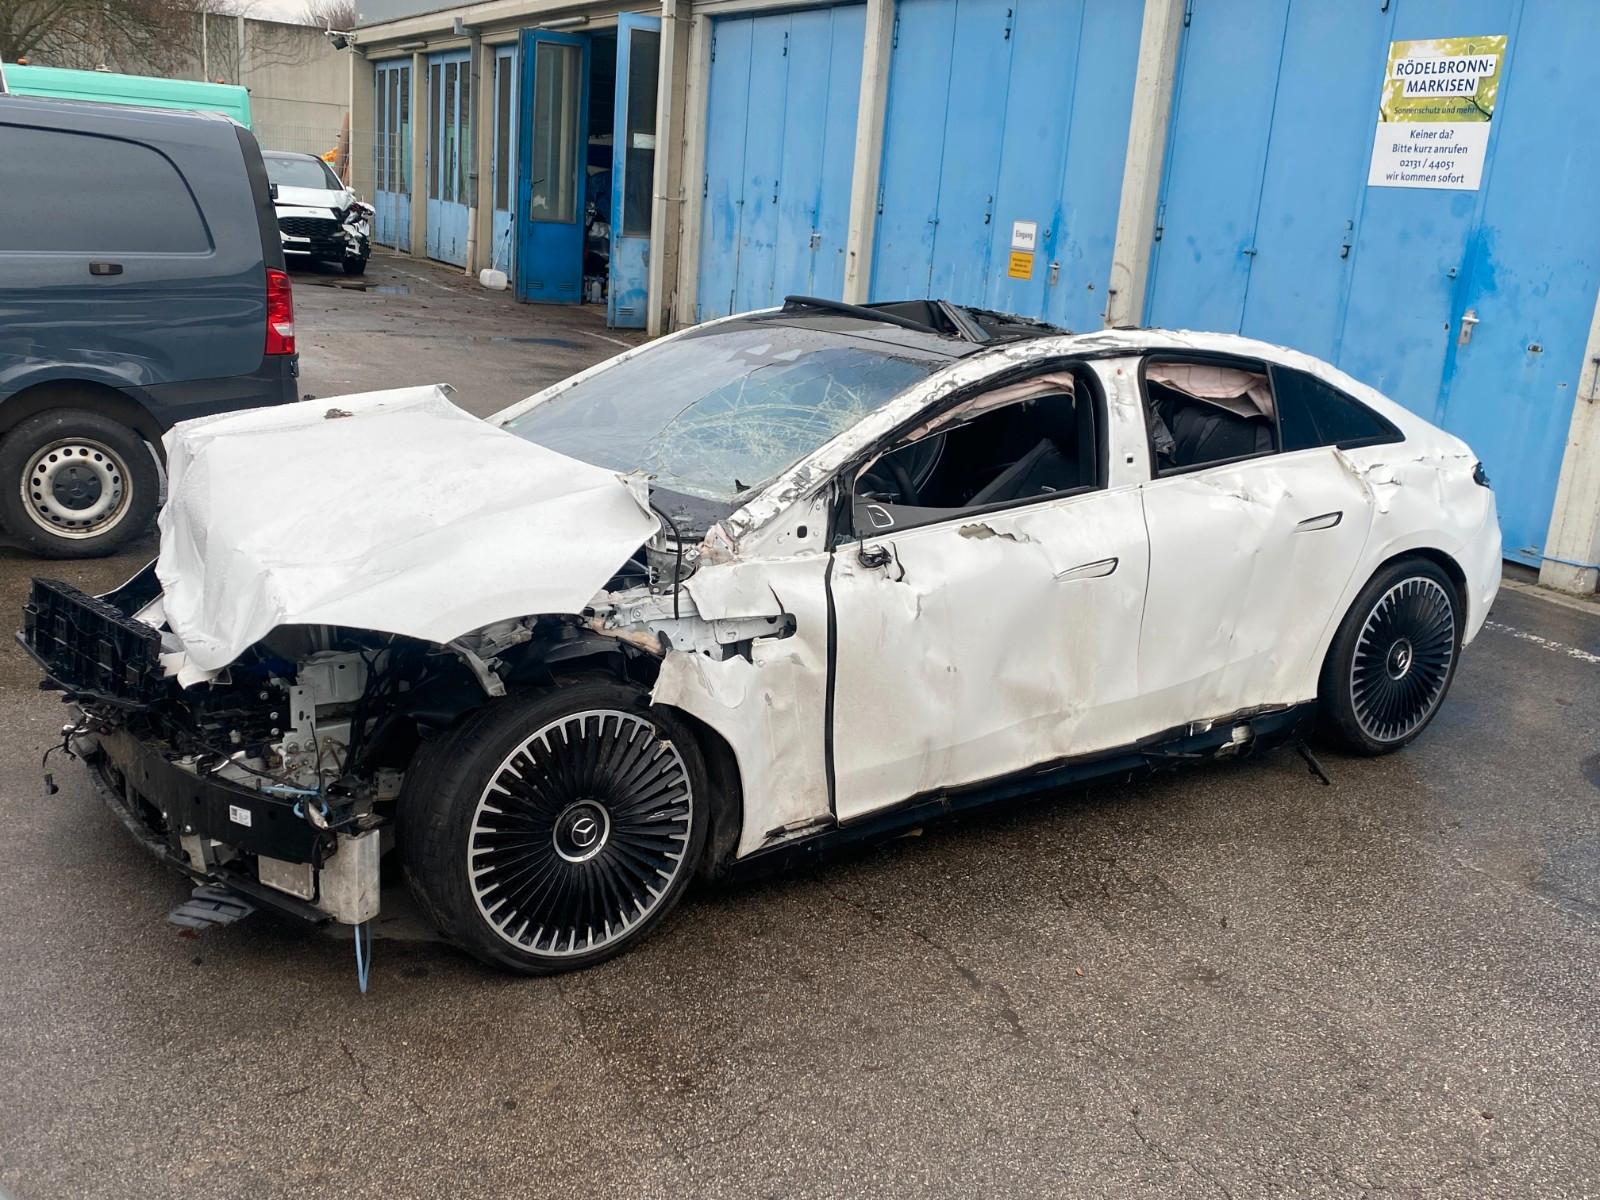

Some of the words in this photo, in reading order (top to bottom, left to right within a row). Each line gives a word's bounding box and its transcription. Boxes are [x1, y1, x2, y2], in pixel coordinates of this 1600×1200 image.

[1396, 59, 1493, 76] RÖDELBRONN-
[1406, 79, 1475, 92] MARKISEN
[1394, 106, 1440, 114] Sonnenschutz
[1442, 106, 1455, 114] und
[1410, 129, 1437, 139] Keiner
[1439, 130, 1454, 140] da?
[1392, 143, 1412, 153] Bitte
[1414, 143, 1432, 154] kurz
[1434, 145, 1468, 154] anrufen
[1399, 160, 1421, 168] 02131
[1422, 159, 1428, 168] /
[1429, 160, 1454, 169] 44051
[1386, 171, 1399, 181] wir
[1400, 172, 1436, 182] kommen
[1438, 173, 1464, 183] sofort
